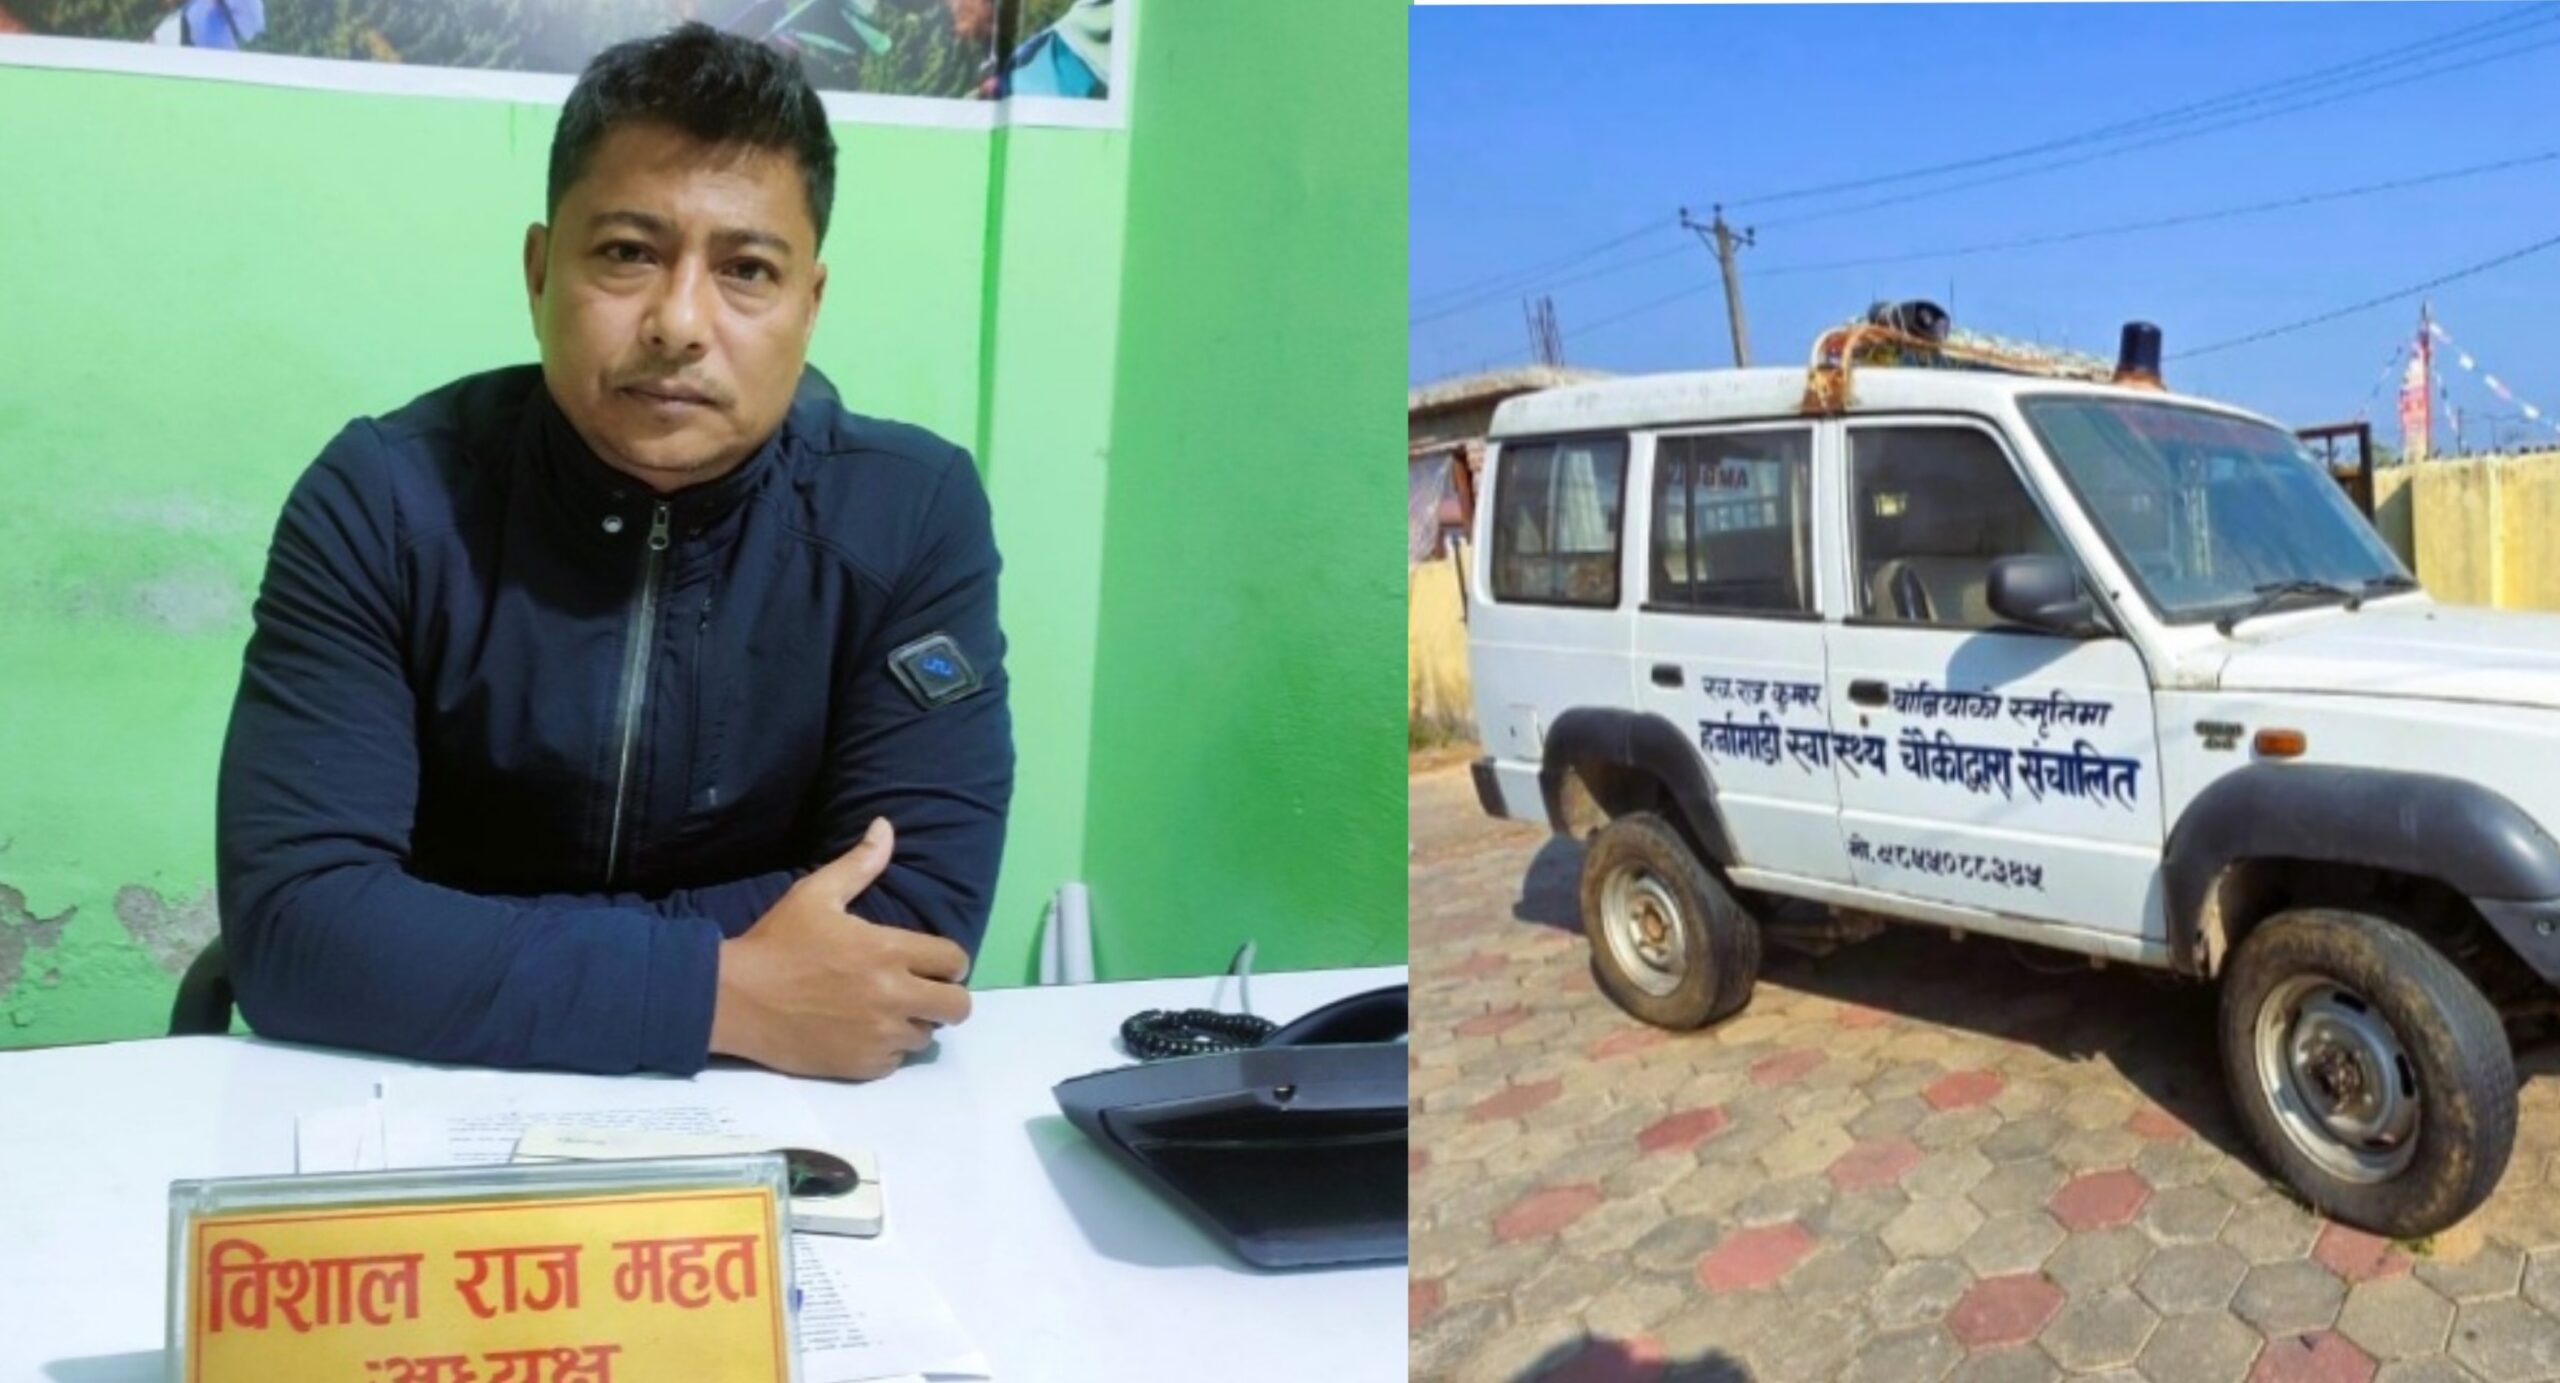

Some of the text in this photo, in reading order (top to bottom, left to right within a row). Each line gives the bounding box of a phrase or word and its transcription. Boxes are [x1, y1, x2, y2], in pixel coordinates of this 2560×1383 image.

[2009, 689, 2112, 738] स्मृतिमा
[2018, 739, 2141, 811] संचालित
[207, 1238, 424, 1333] विशाल
[454, 1244, 582, 1319] राज
[612, 1234, 759, 1309] महत
